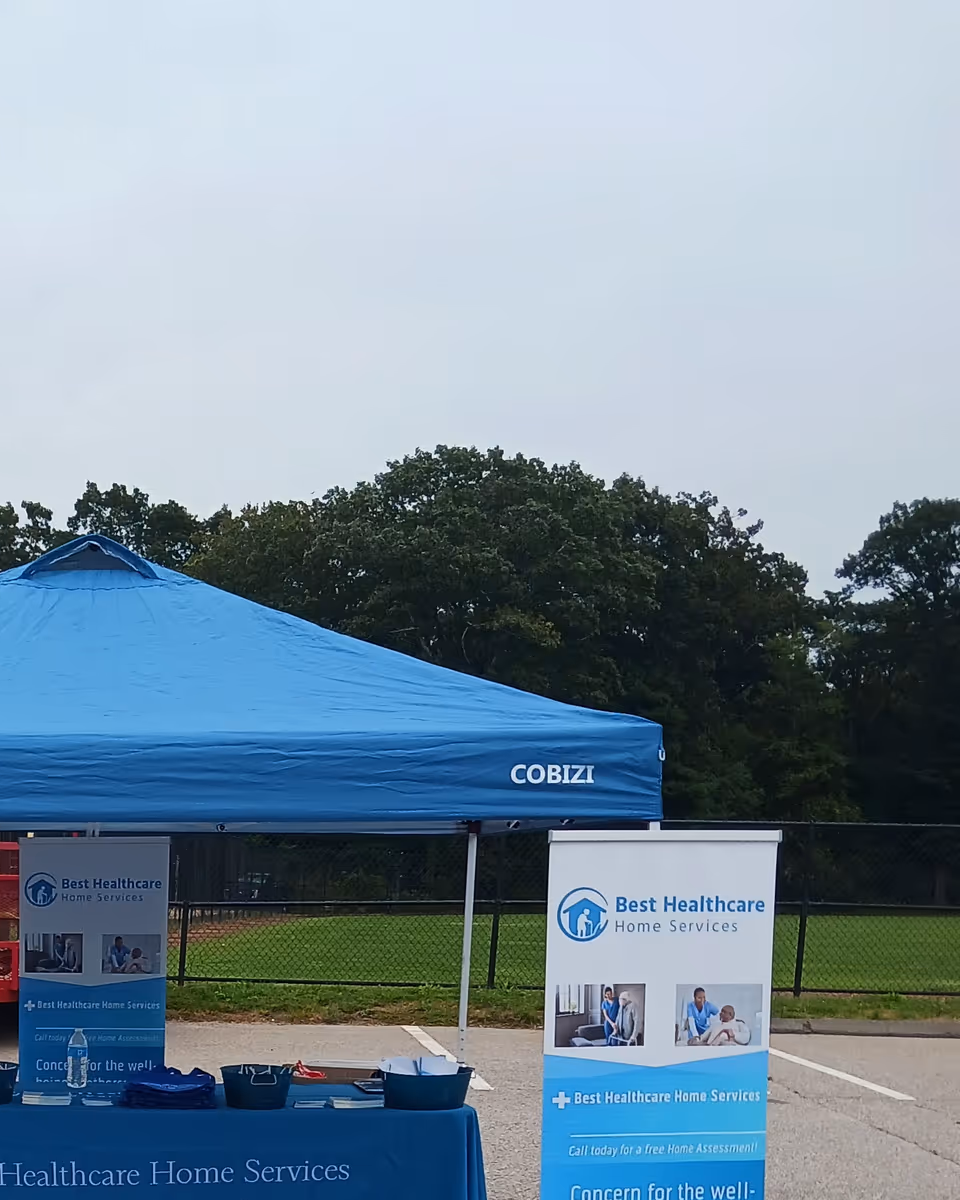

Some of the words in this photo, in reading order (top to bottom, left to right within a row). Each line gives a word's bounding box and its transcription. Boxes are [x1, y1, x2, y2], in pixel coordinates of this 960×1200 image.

[510, 764, 595, 785] COBIZI
[62, 878, 89, 889] Best
[93, 878, 162, 890] Healthcare
[62, 893, 92, 902] Home
[97, 893, 144, 903] Services
[616, 896, 656, 913] Best
[663, 896, 765, 914] Healthcare
[615, 920, 662, 933] Home
[669, 919, 739, 933] Services
[37, 1001, 55, 1010] Best
[57, 1001, 100, 1010] Healthcare
[102, 1001, 125, 1010] Home
[127, 1001, 160, 1010] Services
[35, 1059, 69, 1072] Conce
[87, 1059, 101, 1072] for
[106, 1059, 125, 1072] the
[574, 1092, 602, 1106] Best
[605, 1091, 671, 1105] Healthcare
[675, 1090, 707, 1103] Home
[711, 1089, 760, 1103] Services
[568, 1145, 589, 1158] Call
[591, 1145, 618, 1158] today
[620, 1144, 633, 1158] for
[636, 1146, 642, 1156] a
[644, 1143, 665, 1157] free
[667, 1143, 694, 1155] Home
[150, 1161, 233, 1185] Home
[245, 1159, 349, 1182] Services
[710, 1181, 756, 1200] well-
